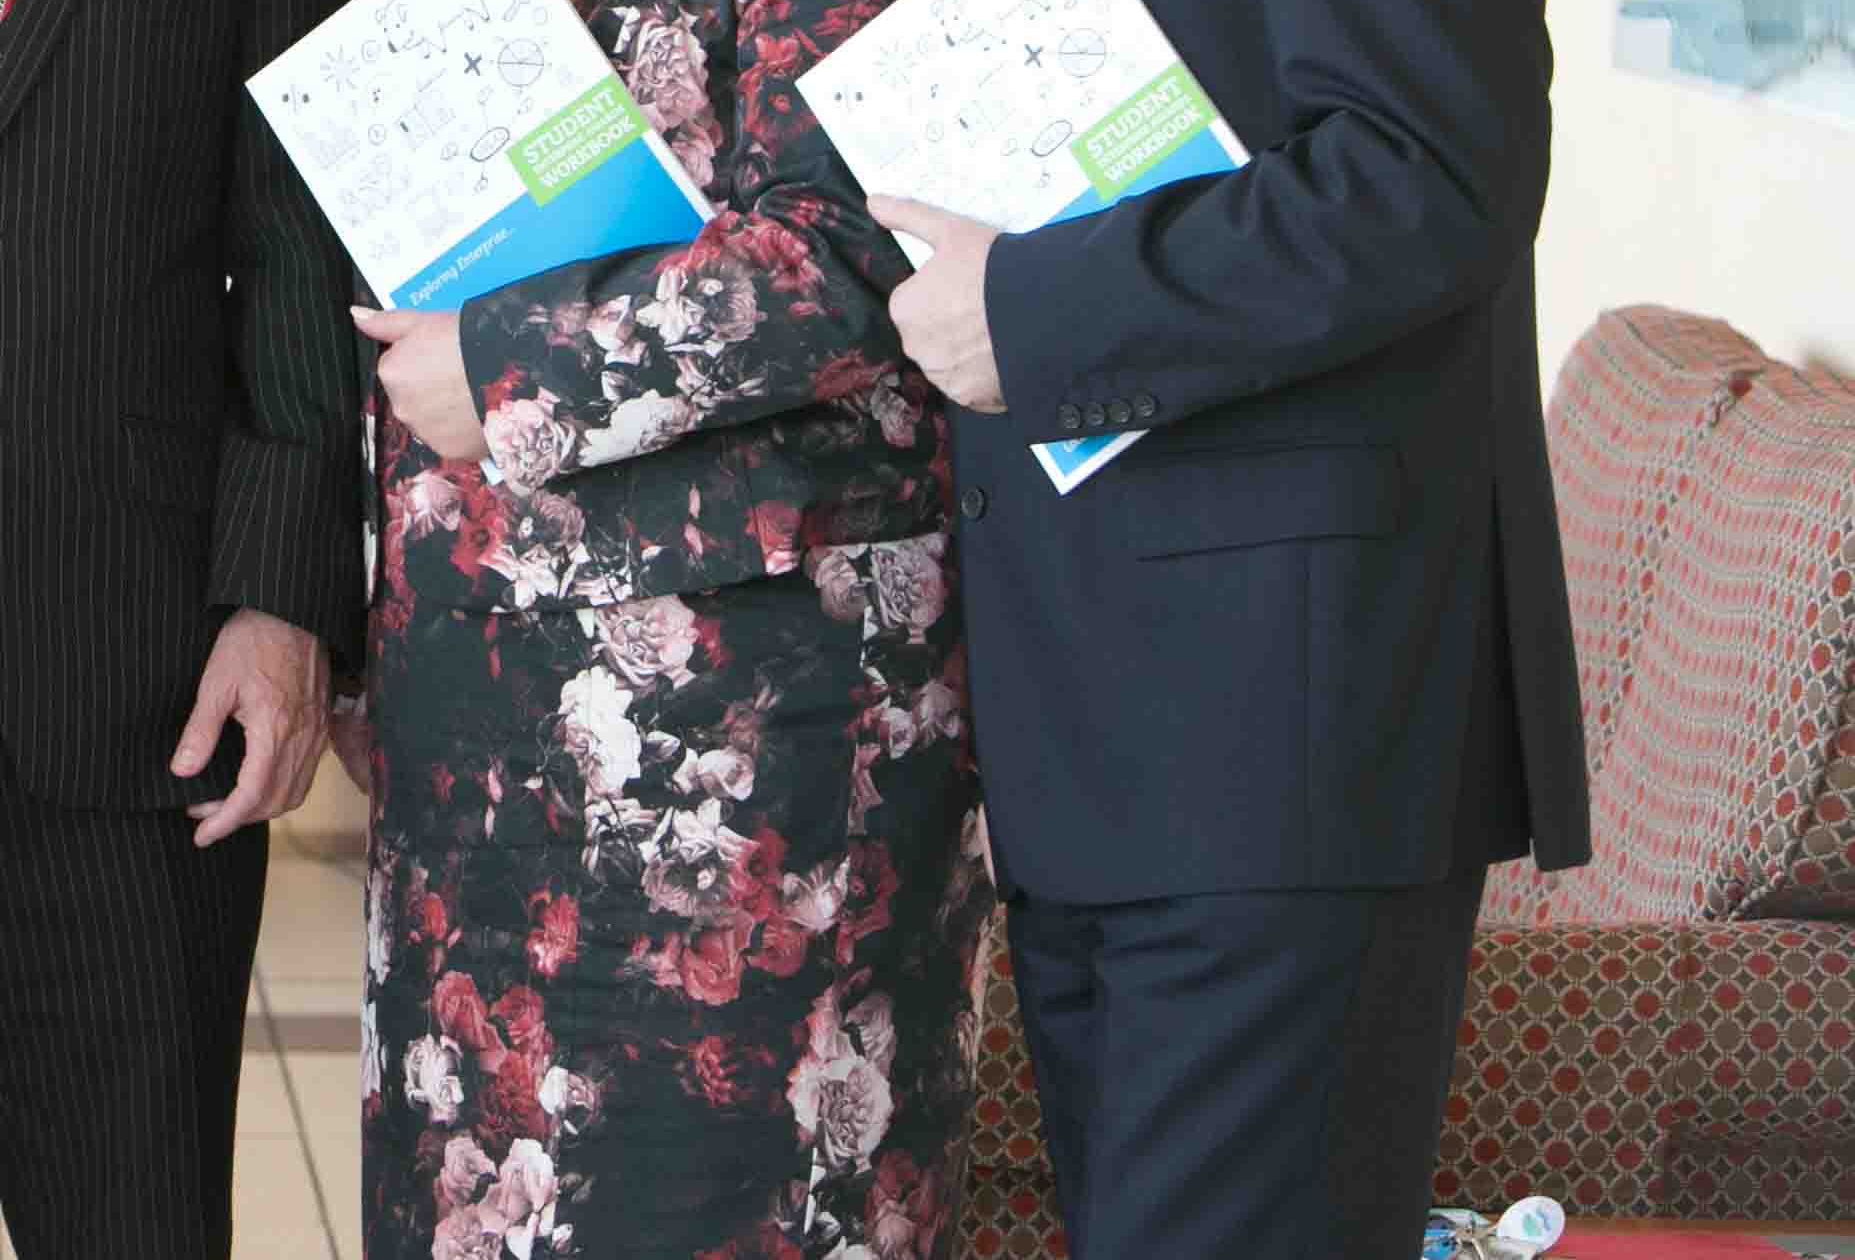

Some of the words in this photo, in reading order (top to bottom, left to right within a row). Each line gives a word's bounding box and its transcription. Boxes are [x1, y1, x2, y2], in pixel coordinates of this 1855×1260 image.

[522, 89, 616, 165] STUDENT
[539, 116, 637, 187] WORKBOOK
[1088, 76, 1183, 158] STUDENT
[1103, 105, 1202, 184] WORKBOOK
[409, 266, 459, 307] Exploring
